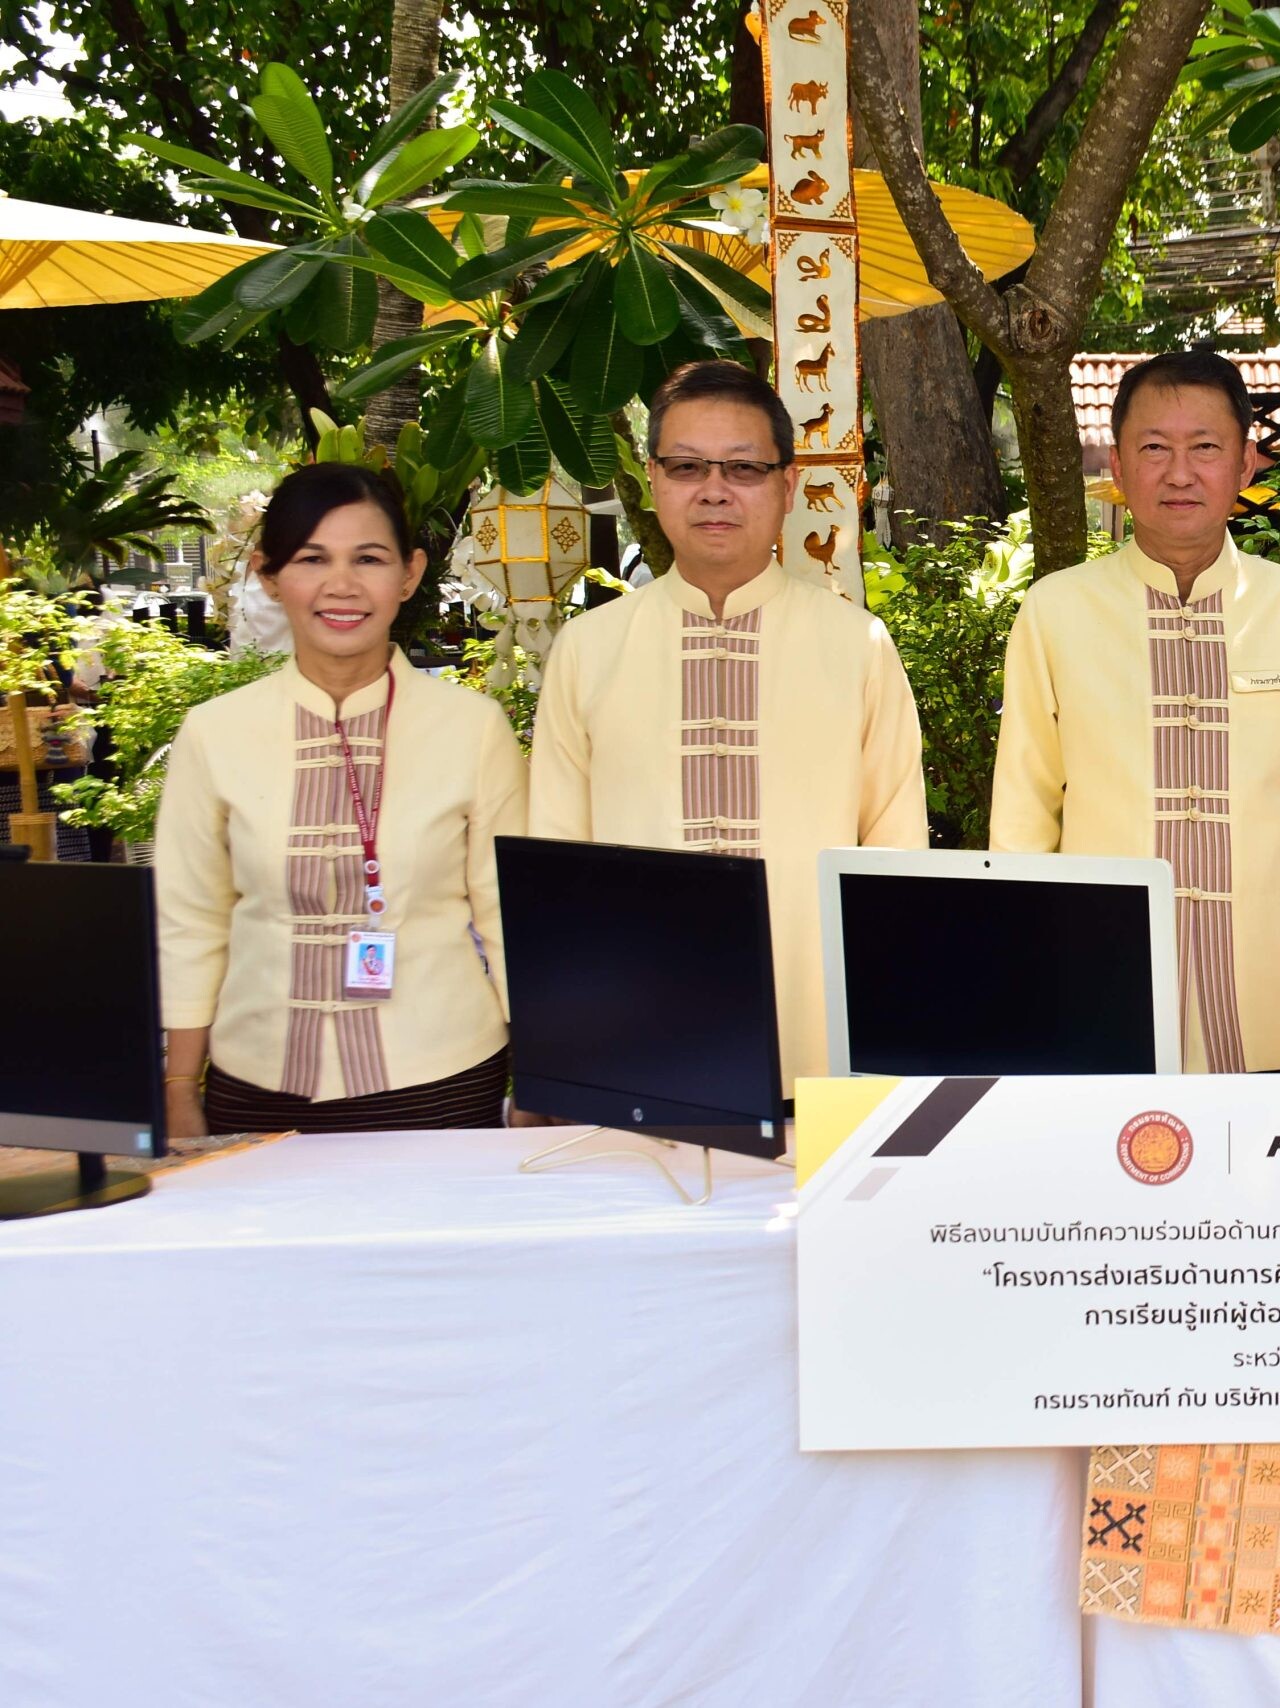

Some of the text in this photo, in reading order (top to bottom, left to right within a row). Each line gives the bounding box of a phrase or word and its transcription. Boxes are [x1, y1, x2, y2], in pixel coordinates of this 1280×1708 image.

[1128, 1114, 1185, 1132] กรมราชทัณฑ์
[1121, 1143, 1149, 1181] DEPARTMENT
[1149, 1174, 1159, 1182] OF
[1033, 1387, 1170, 1410] กรมราชทัณฑ์
[1178, 1388, 1207, 1408] กับ
